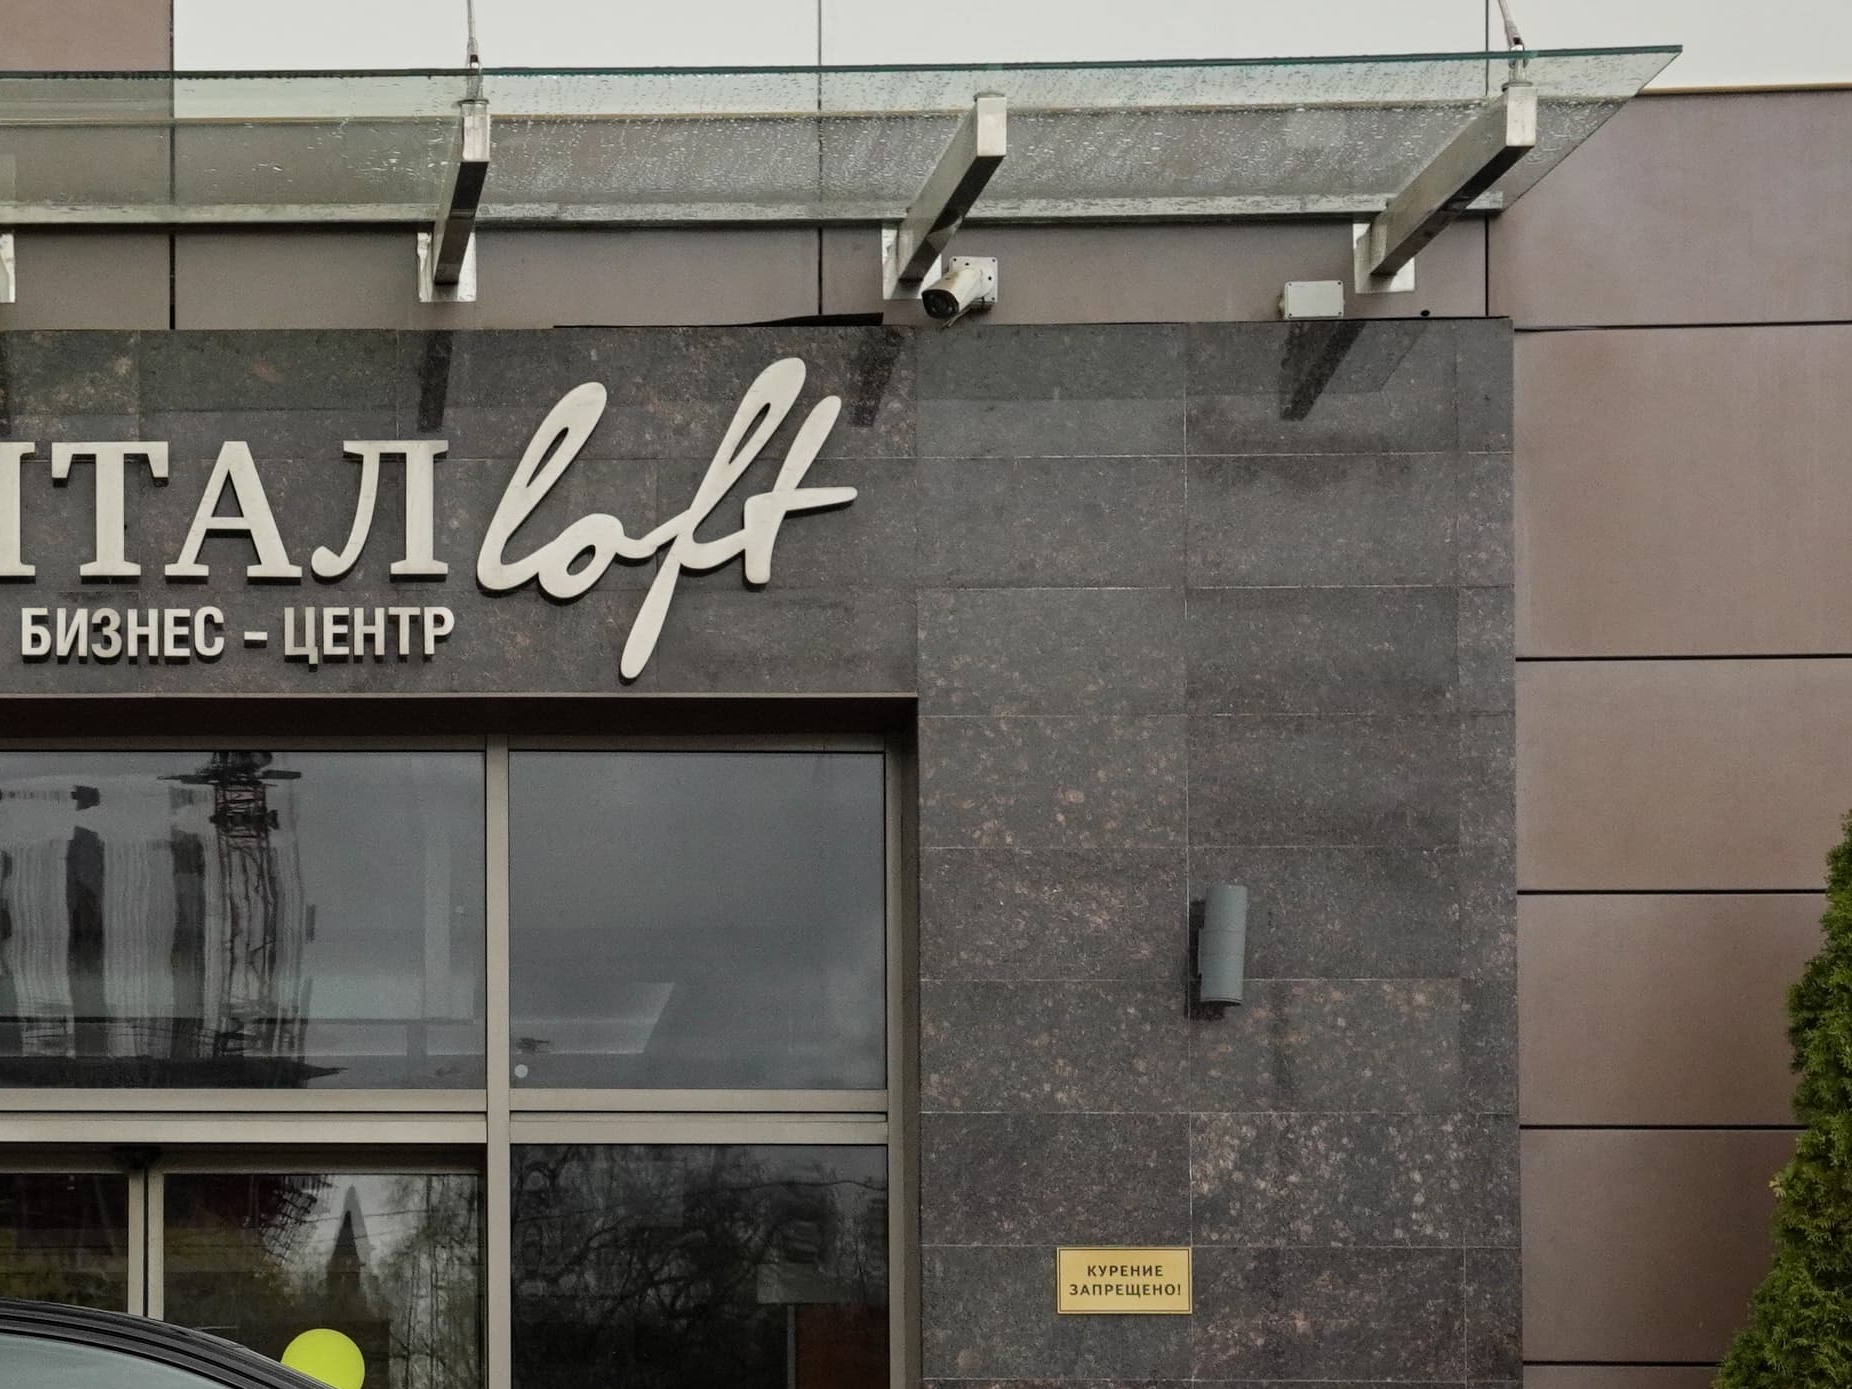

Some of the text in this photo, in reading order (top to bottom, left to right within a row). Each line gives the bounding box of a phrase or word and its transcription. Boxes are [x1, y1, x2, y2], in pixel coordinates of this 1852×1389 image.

[476, 357, 859, 680] loft
[20, 606, 225, 658] БИЗНЕС
[283, 606, 455, 666] ЦЕНТР
[1086, 1264, 1164, 1277] КУРЕНИЕ
[1068, 1283, 1182, 1298] ЗАПРЕЩЕНО!
